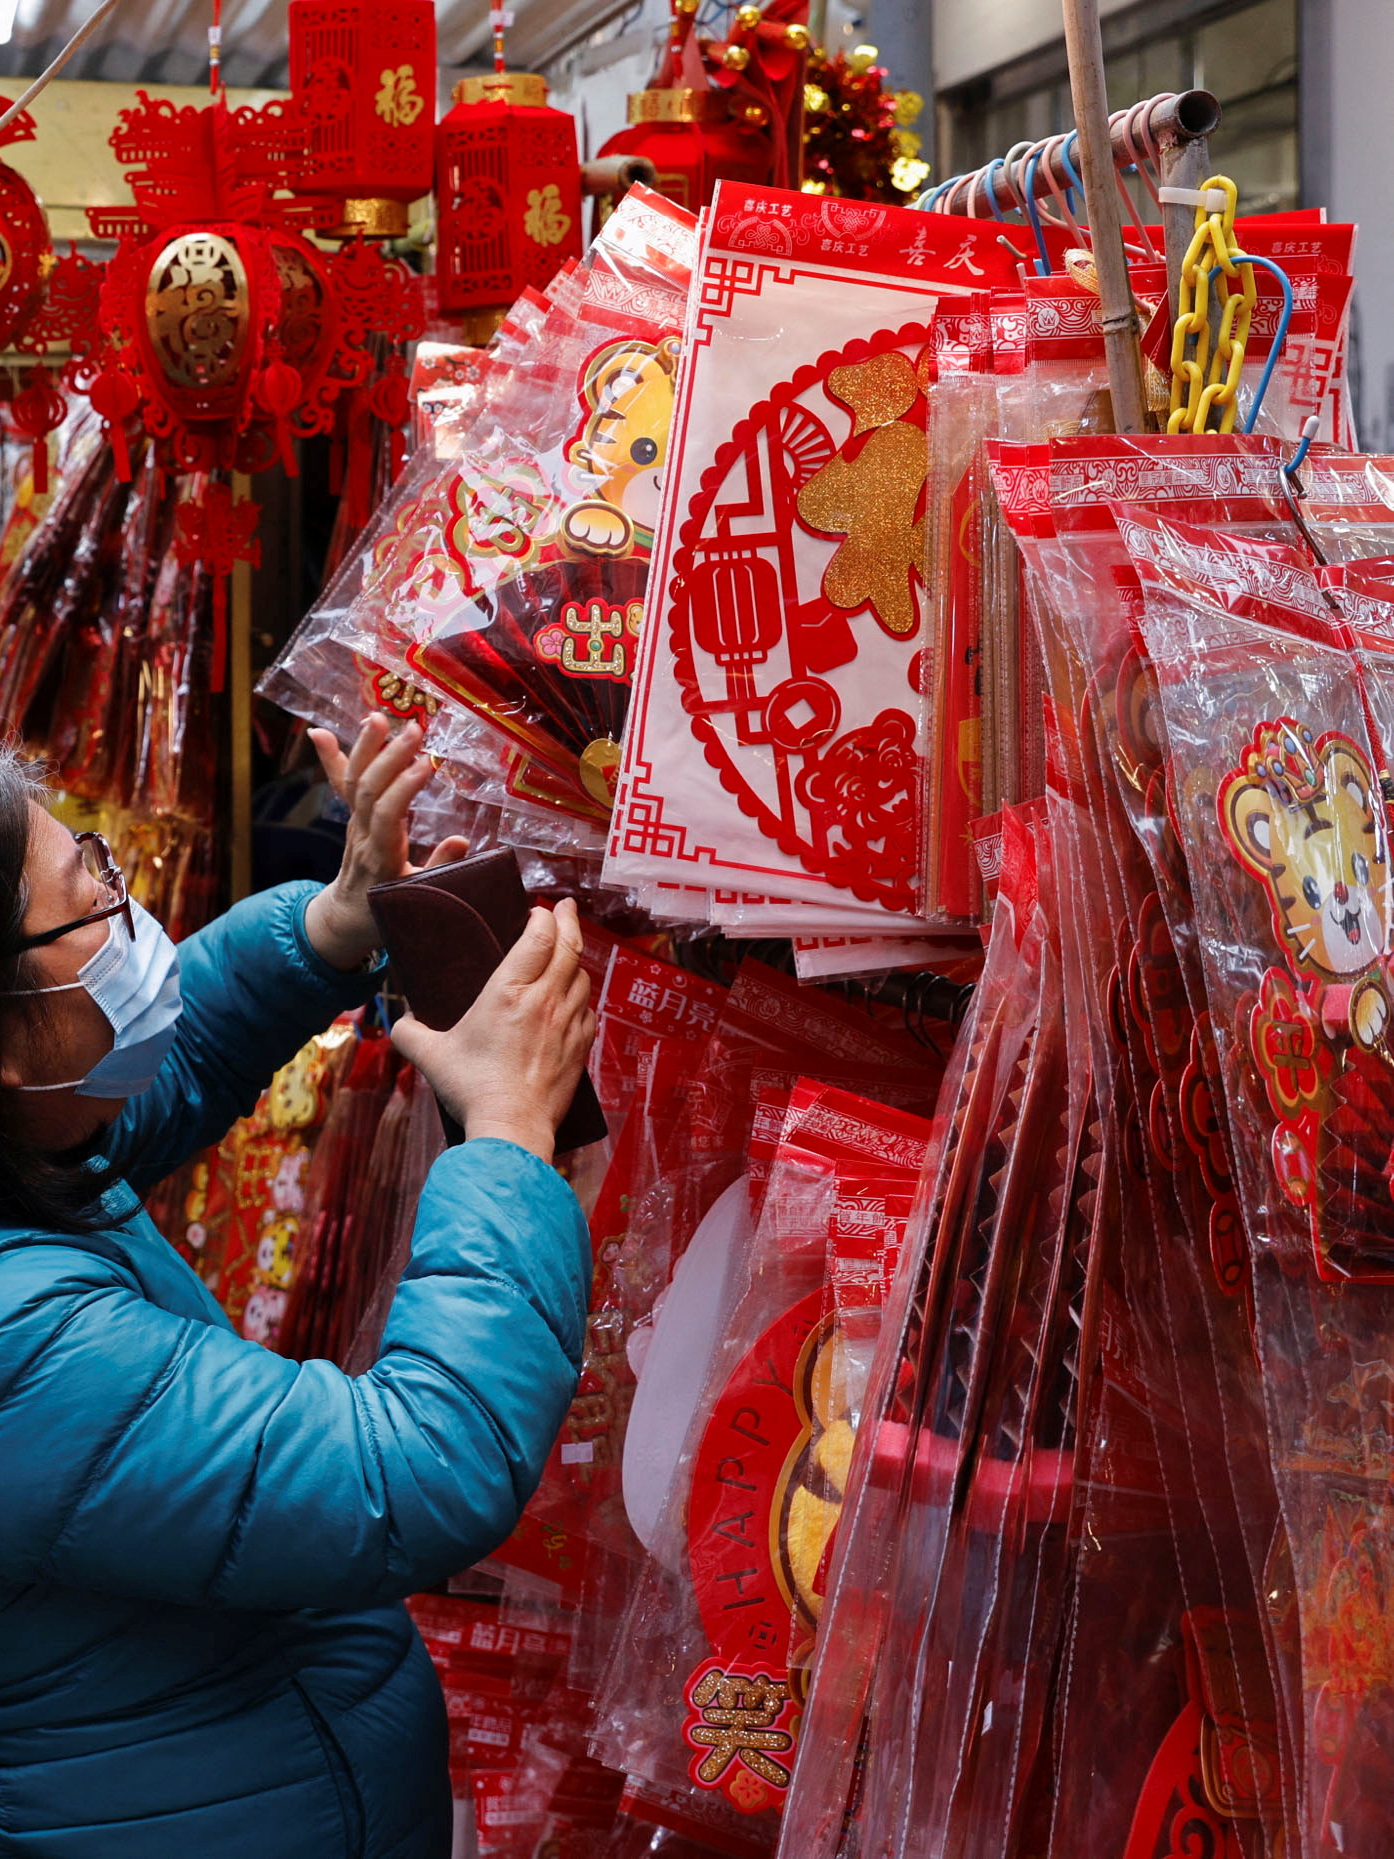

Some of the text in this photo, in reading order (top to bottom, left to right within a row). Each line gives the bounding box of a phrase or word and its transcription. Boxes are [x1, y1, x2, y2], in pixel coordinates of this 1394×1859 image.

[374, 64, 424, 128] 福
[523, 183, 572, 248] 福
[743, 199, 793, 217] 喜庆工艺
[820, 238, 870, 257] 喜庆工艺
[899, 226, 986, 276] 喜庆
[560, 603, 626, 677] 出
[627, 976, 719, 1033] 蓝月亮
[1270, 1019, 1311, 1092] 平
[710, 1358, 795, 1612] HAPPY
